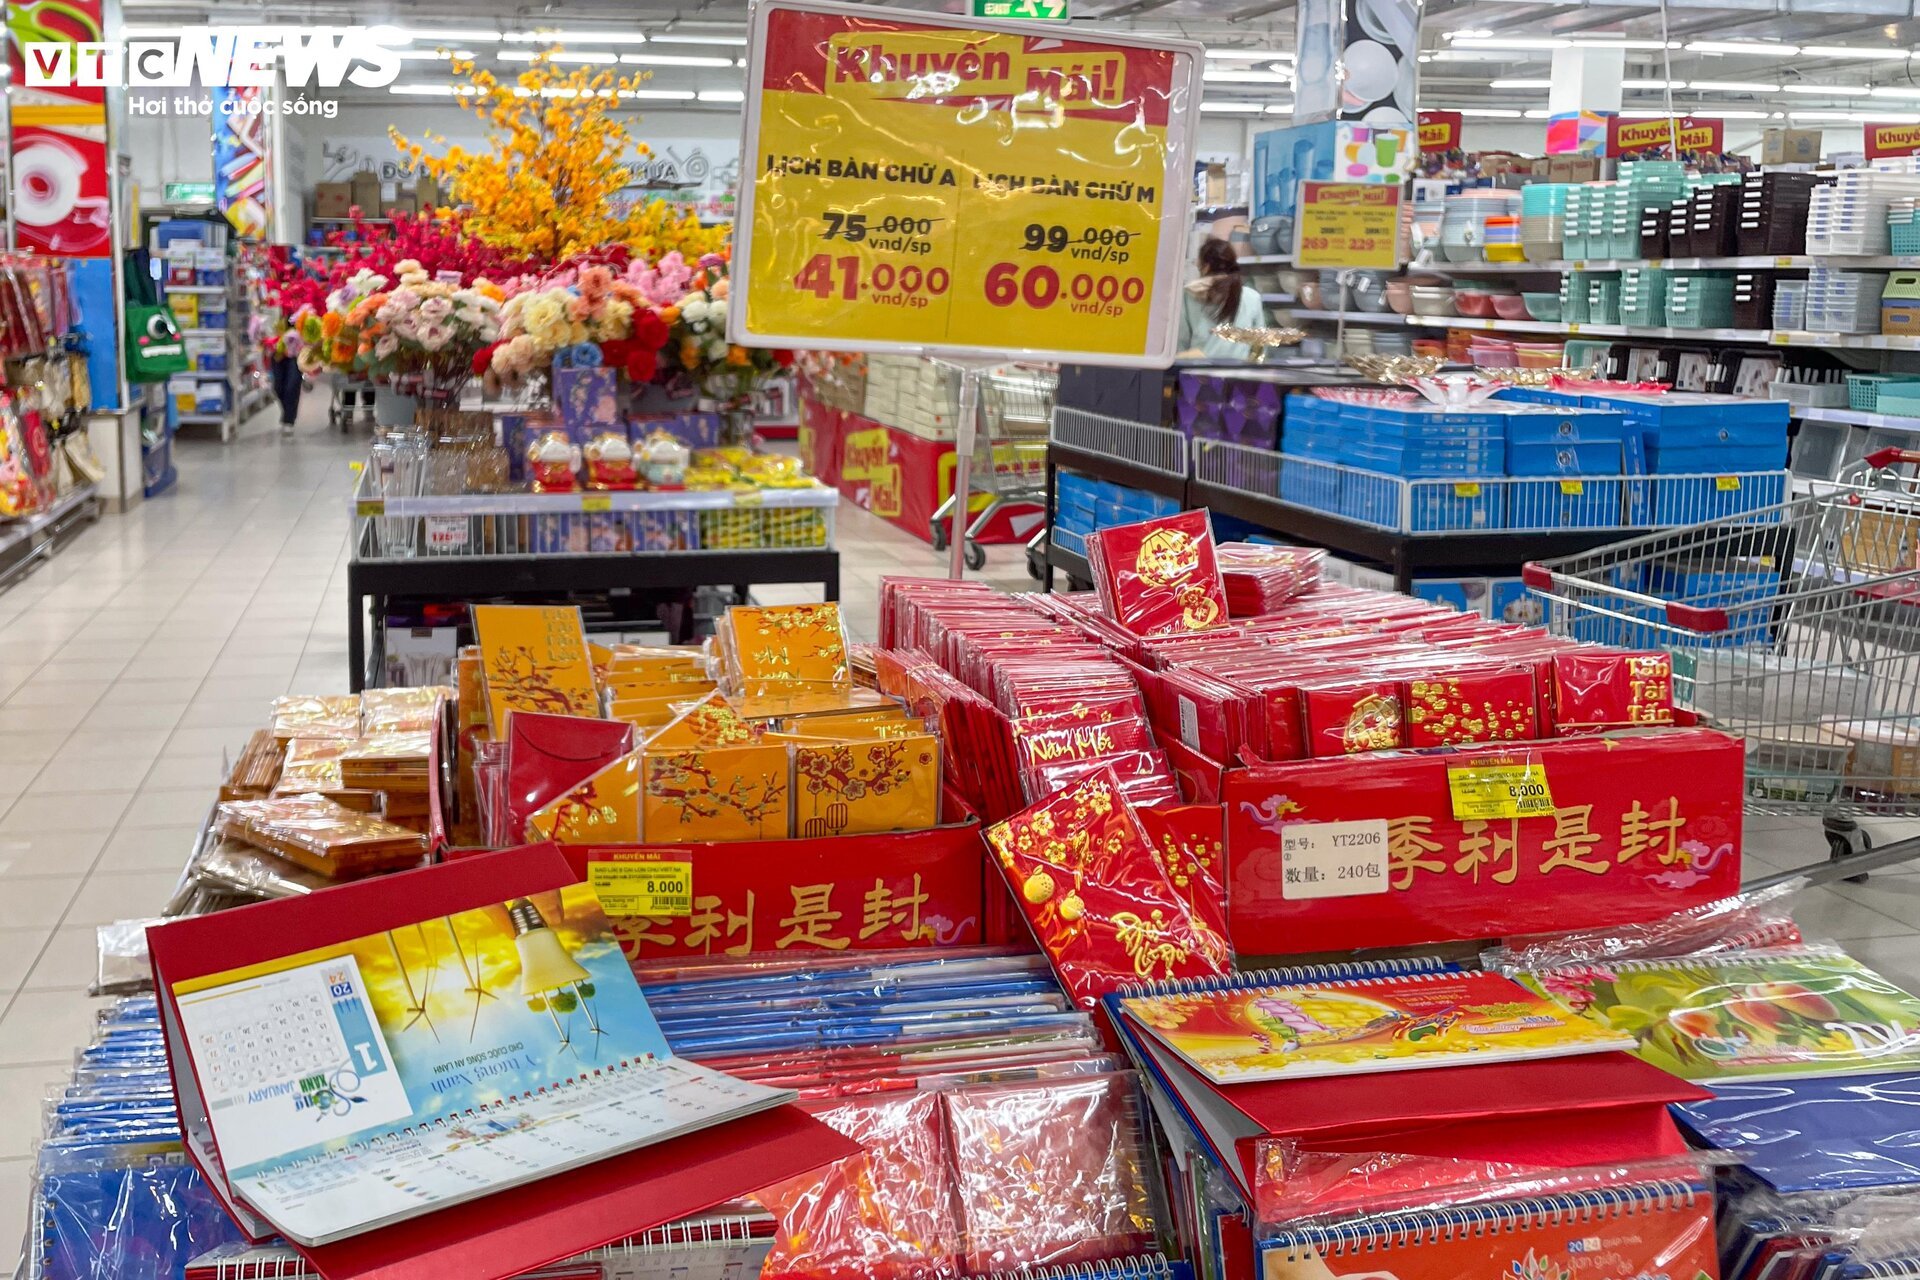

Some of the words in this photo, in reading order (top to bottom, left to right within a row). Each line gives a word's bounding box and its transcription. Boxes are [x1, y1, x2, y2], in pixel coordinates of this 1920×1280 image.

[834, 43, 1010, 84] Khuyến
[767, 155, 822, 177] LỊCH
[827, 157, 878, 180] BÀN
[885, 163, 937, 184] CHỮ
[938, 169, 957, 186] A
[1031, 174, 1079, 197] BÀN
[1085, 181, 1134, 202] CHỮ
[1137, 186, 1155, 203] M
[821, 212, 934, 242] 75.000
[869, 237, 932, 255] vnd/sp
[1071, 246, 1130, 264] vnd/sp
[793, 253, 950, 301] 41.000
[984, 262, 1145, 310] 60.000
[872, 292, 929, 309] vnd/sp
[1071, 302, 1123, 317] vnd/sp
[1509, 784, 1545, 797] 8.000
[1332, 832, 1381, 848] YT2206
[1337, 862, 1381, 880] 240包
[647, 881, 683, 893] 8.000
[328, 971, 346, 985] 24
[332, 983, 352, 997] 20
[508, 1042, 524, 1052] CHO
[354, 1042, 378, 1071] 1
[454, 1058, 465, 1069] AN
[248, 1080, 295, 1104] JANUARY
[298, 1073, 328, 1093] XANH
